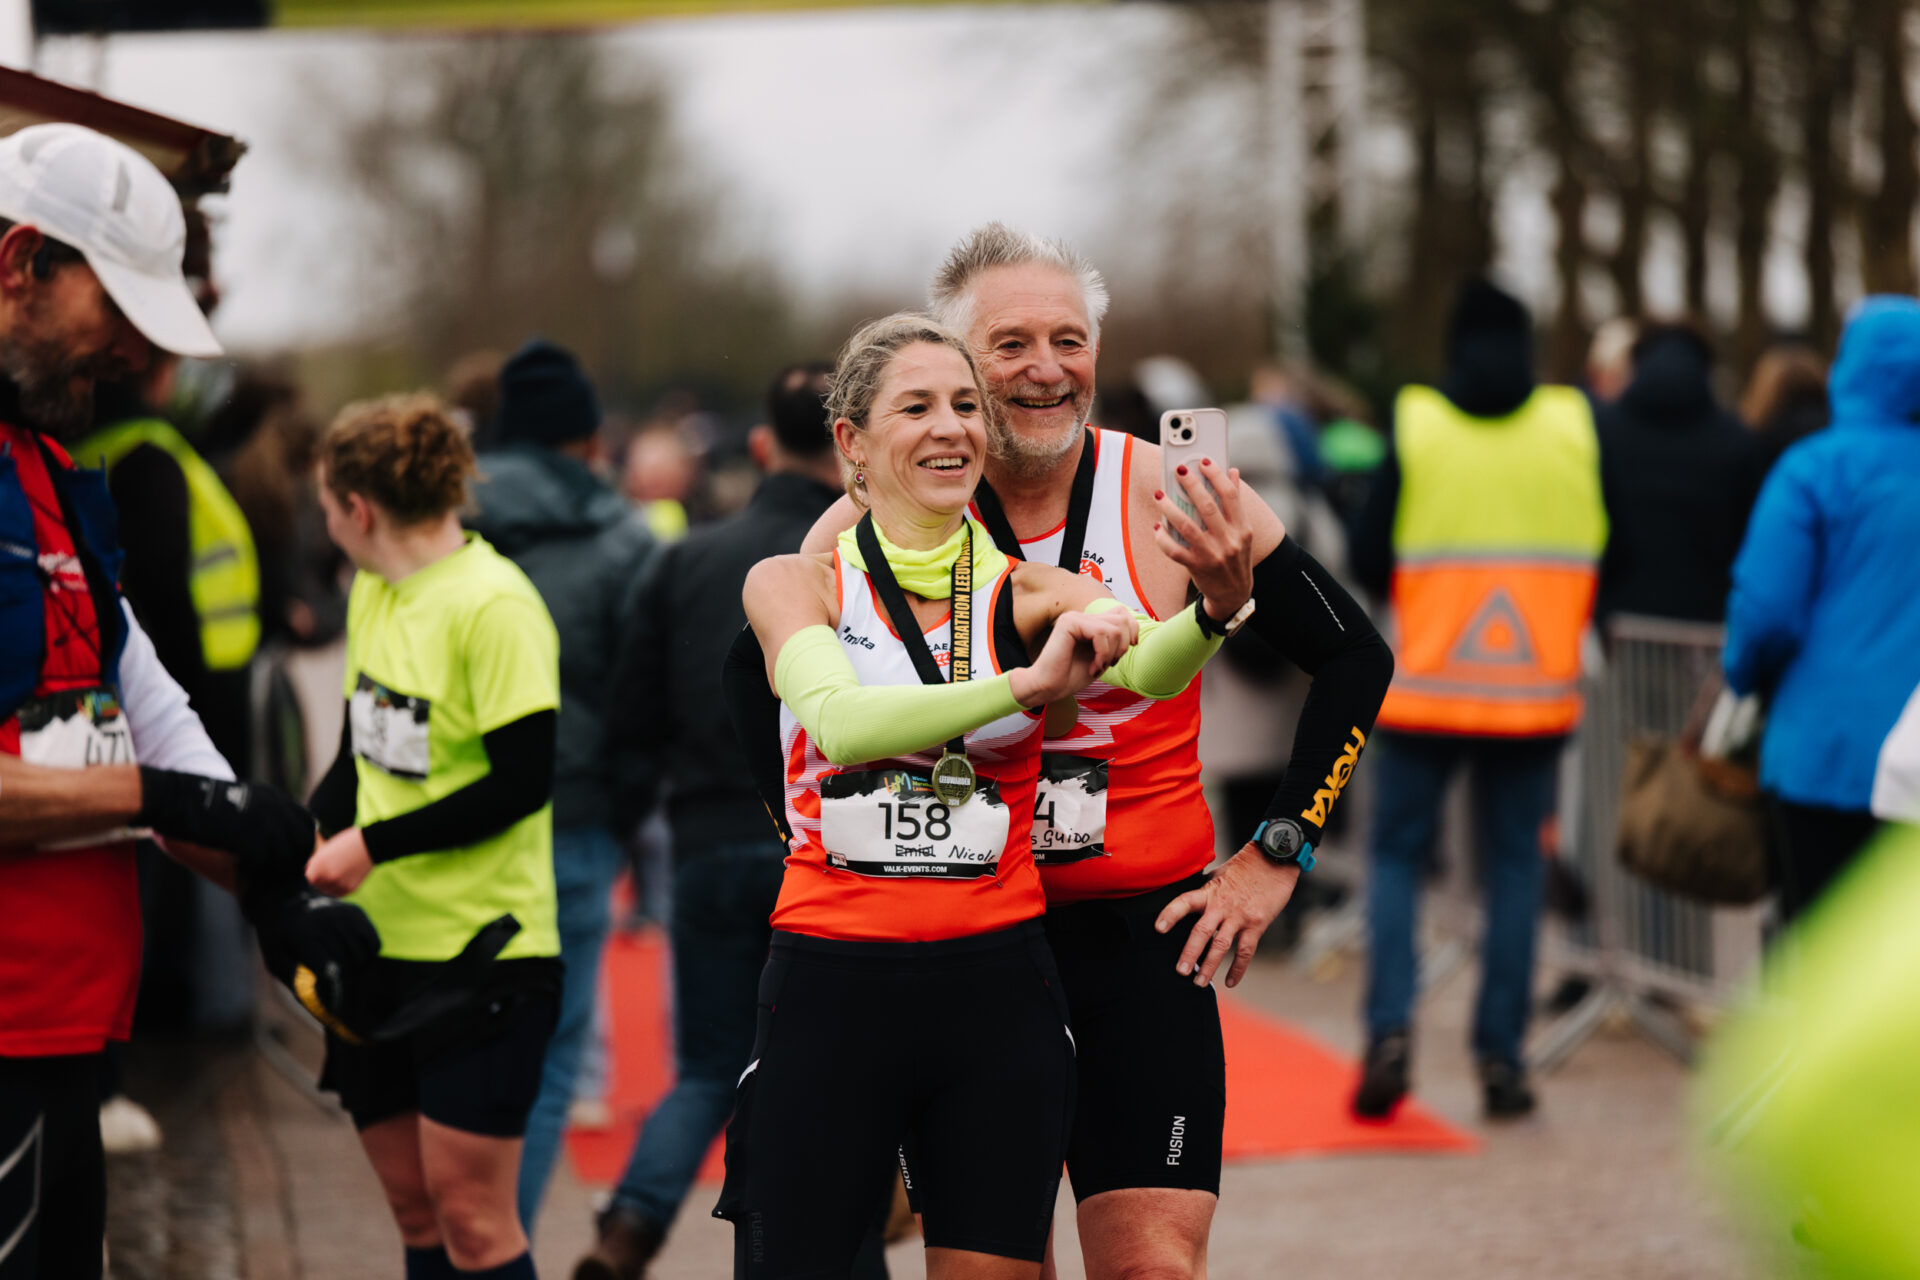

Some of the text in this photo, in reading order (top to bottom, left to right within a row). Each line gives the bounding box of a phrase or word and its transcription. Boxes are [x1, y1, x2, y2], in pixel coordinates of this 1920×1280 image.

[954, 595, 970, 657] MARATHON
[1301, 726, 1366, 828] HOKA
[878, 802, 951, 841] 158
[1033, 792, 1055, 828] 4
[883, 865, 948, 873] VALK-EVENTS.COM
[1166, 1115, 1186, 1166] FUSION
